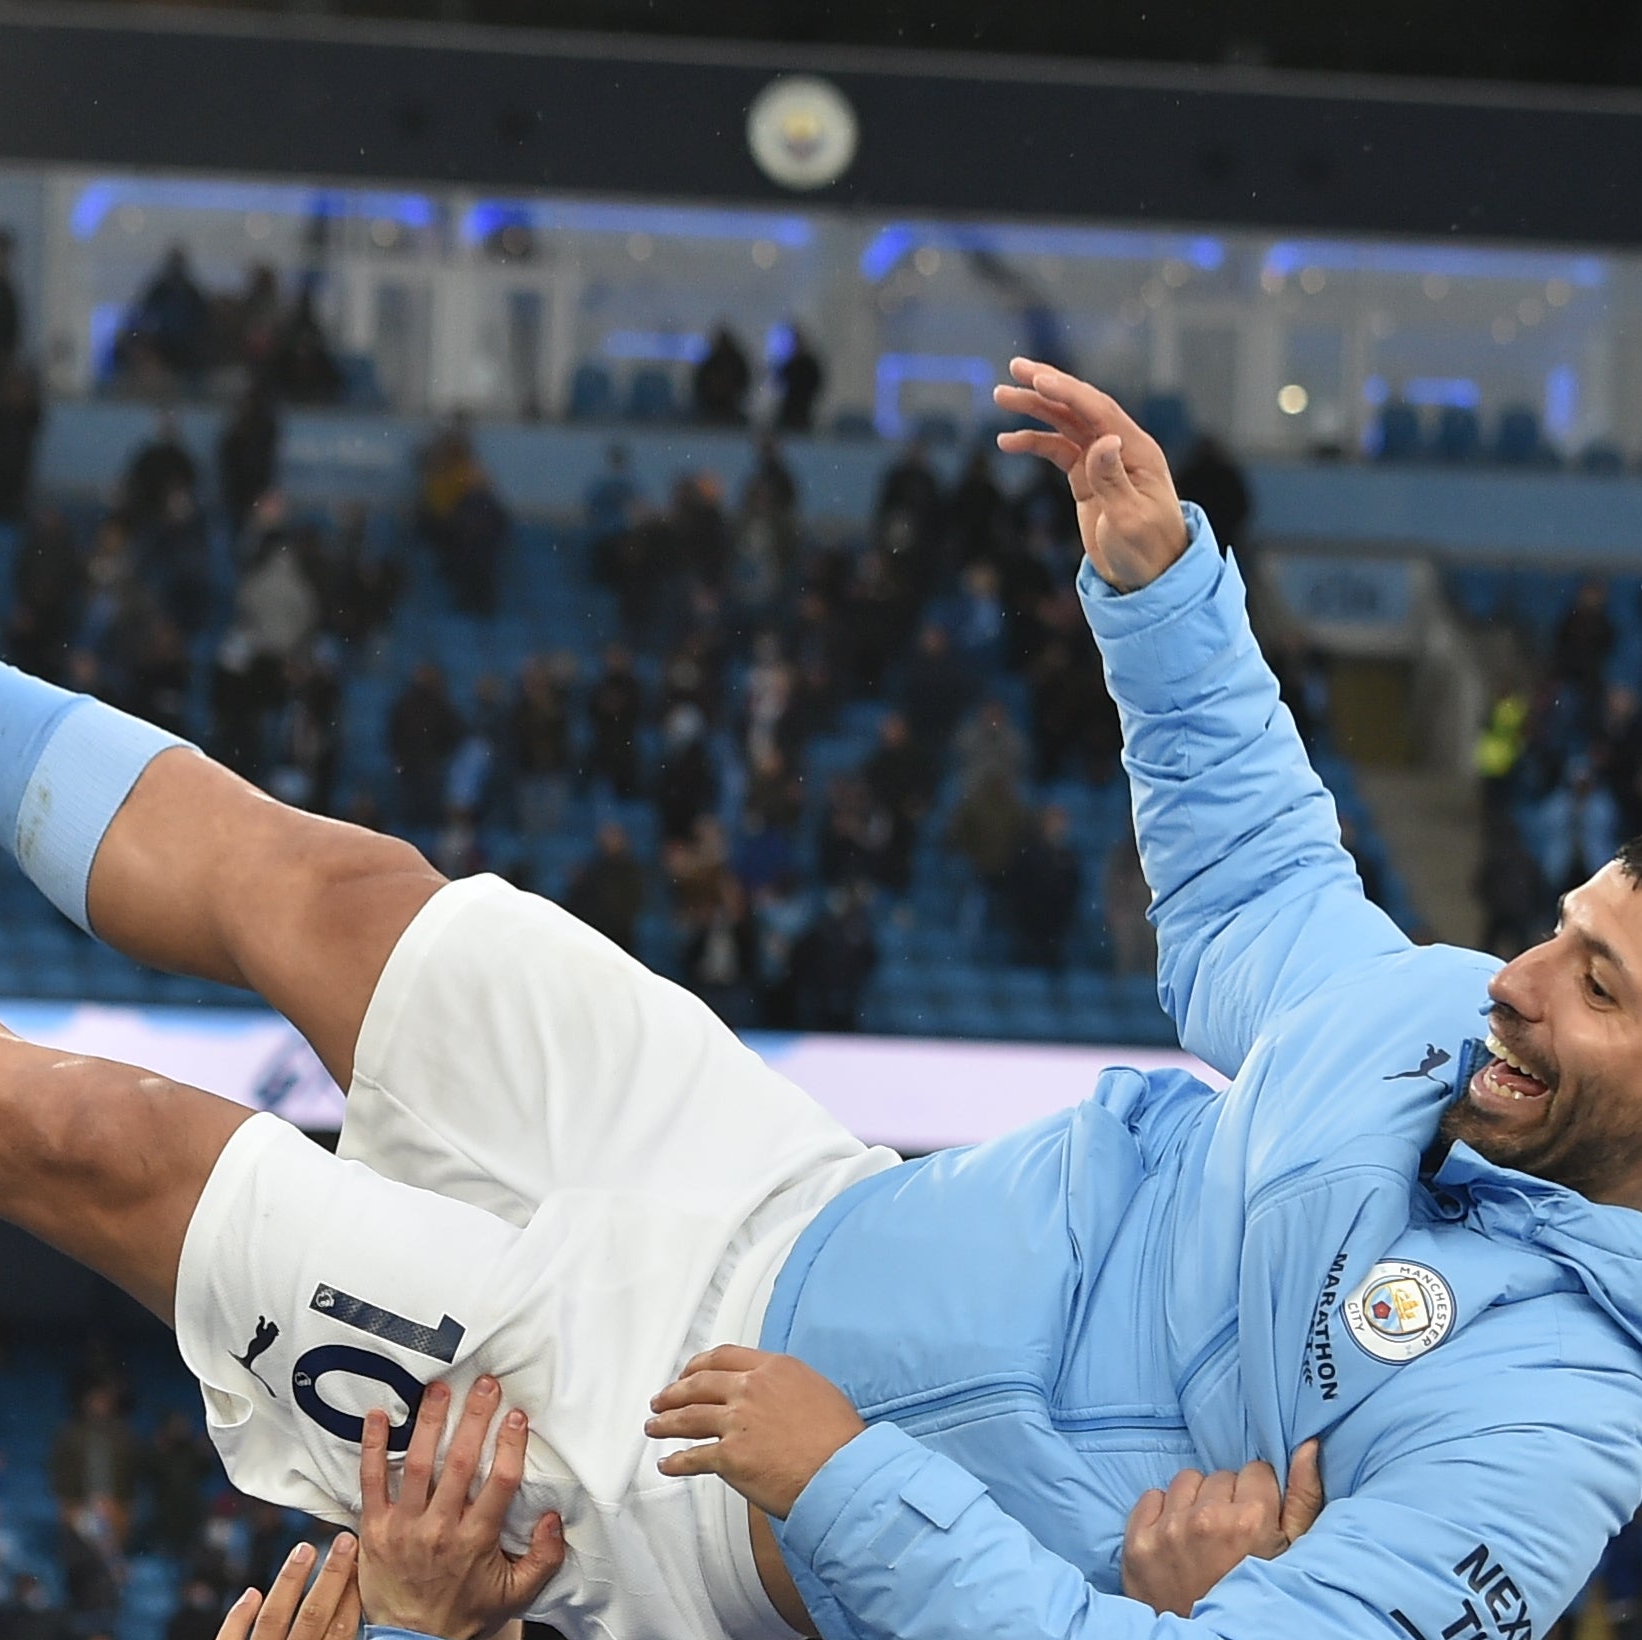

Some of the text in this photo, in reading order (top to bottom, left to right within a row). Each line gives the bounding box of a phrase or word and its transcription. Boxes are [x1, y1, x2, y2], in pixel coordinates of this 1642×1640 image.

[292, 1282, 466, 1459] 10
[1314, 1253, 1348, 1400] MARATHON
[1347, 1266, 1448, 1347] MANCHESTER CITY
